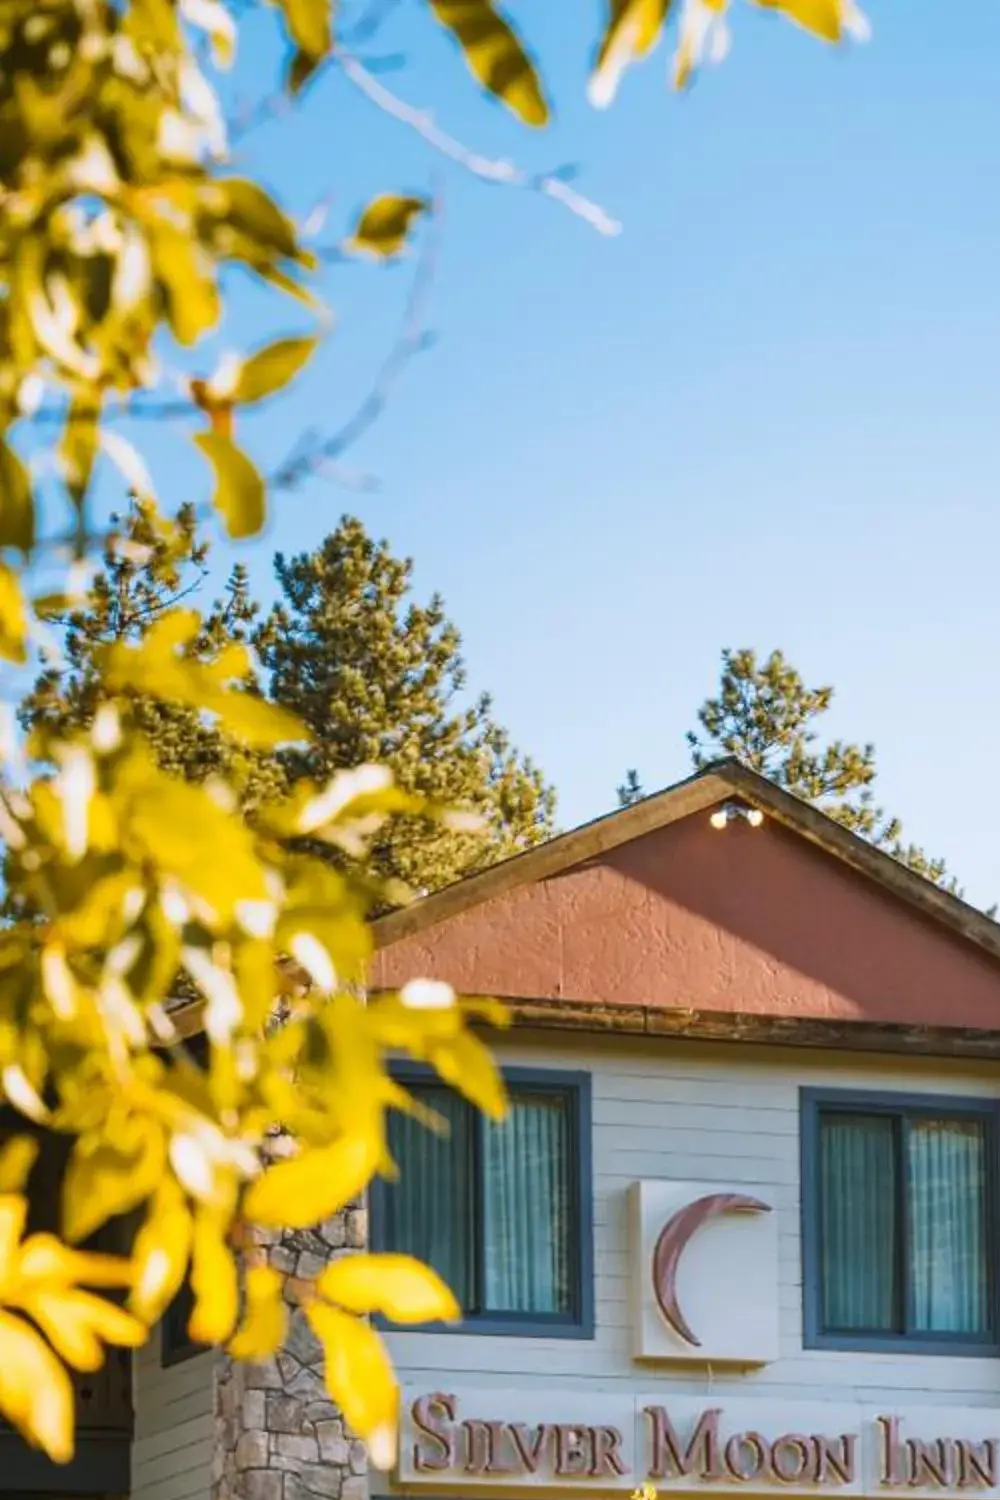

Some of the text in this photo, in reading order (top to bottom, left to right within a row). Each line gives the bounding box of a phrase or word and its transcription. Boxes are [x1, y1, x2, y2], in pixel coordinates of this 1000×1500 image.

[411, 1392, 999, 1488] SILVER MOON INN
